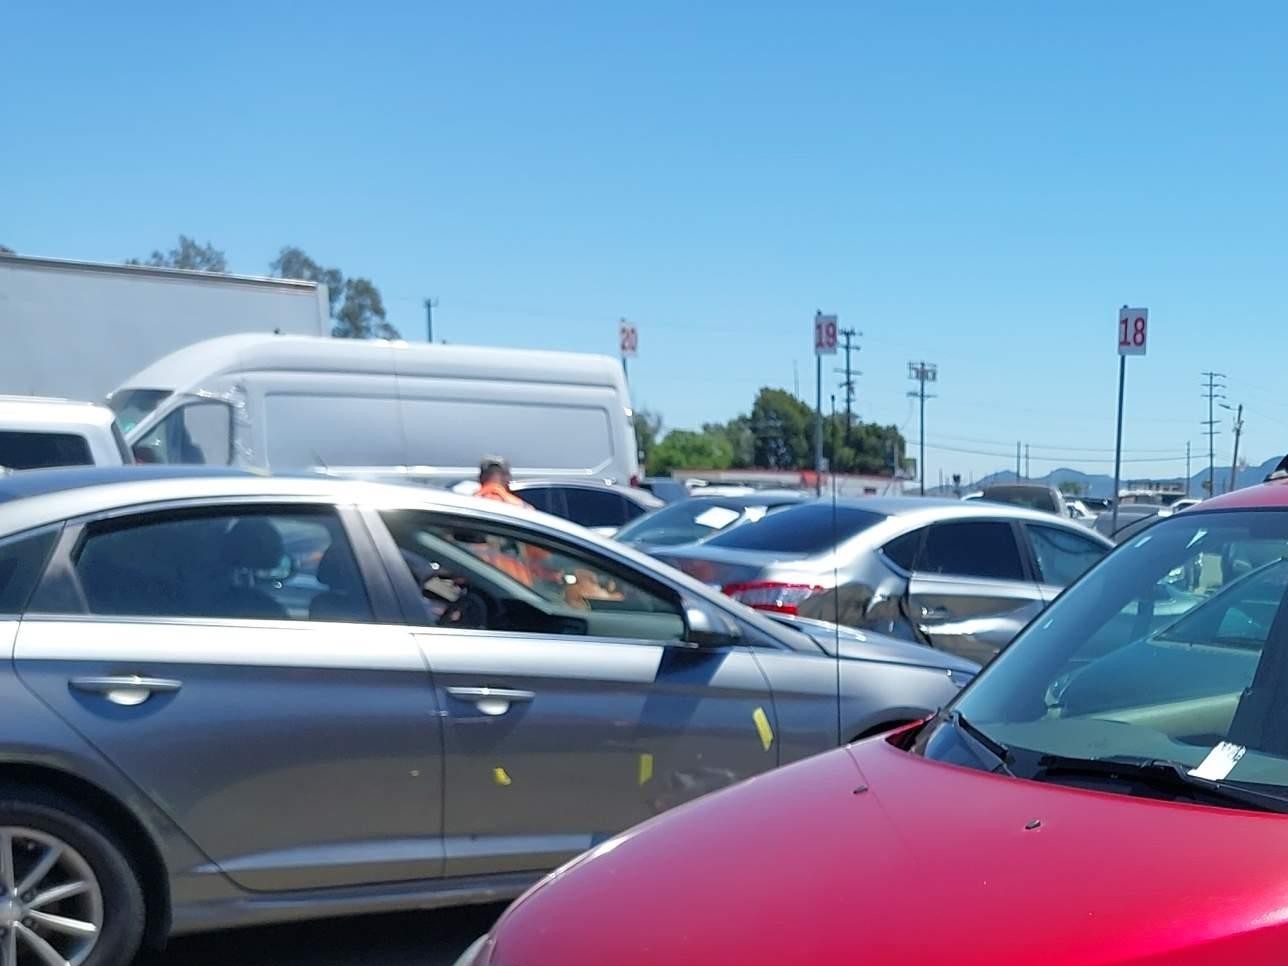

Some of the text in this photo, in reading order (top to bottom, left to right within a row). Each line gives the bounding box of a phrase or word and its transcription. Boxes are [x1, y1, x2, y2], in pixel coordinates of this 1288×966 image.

[621, 326, 638, 353] 20
[815, 322, 837, 348] 19
[1120, 317, 1145, 347] 18
